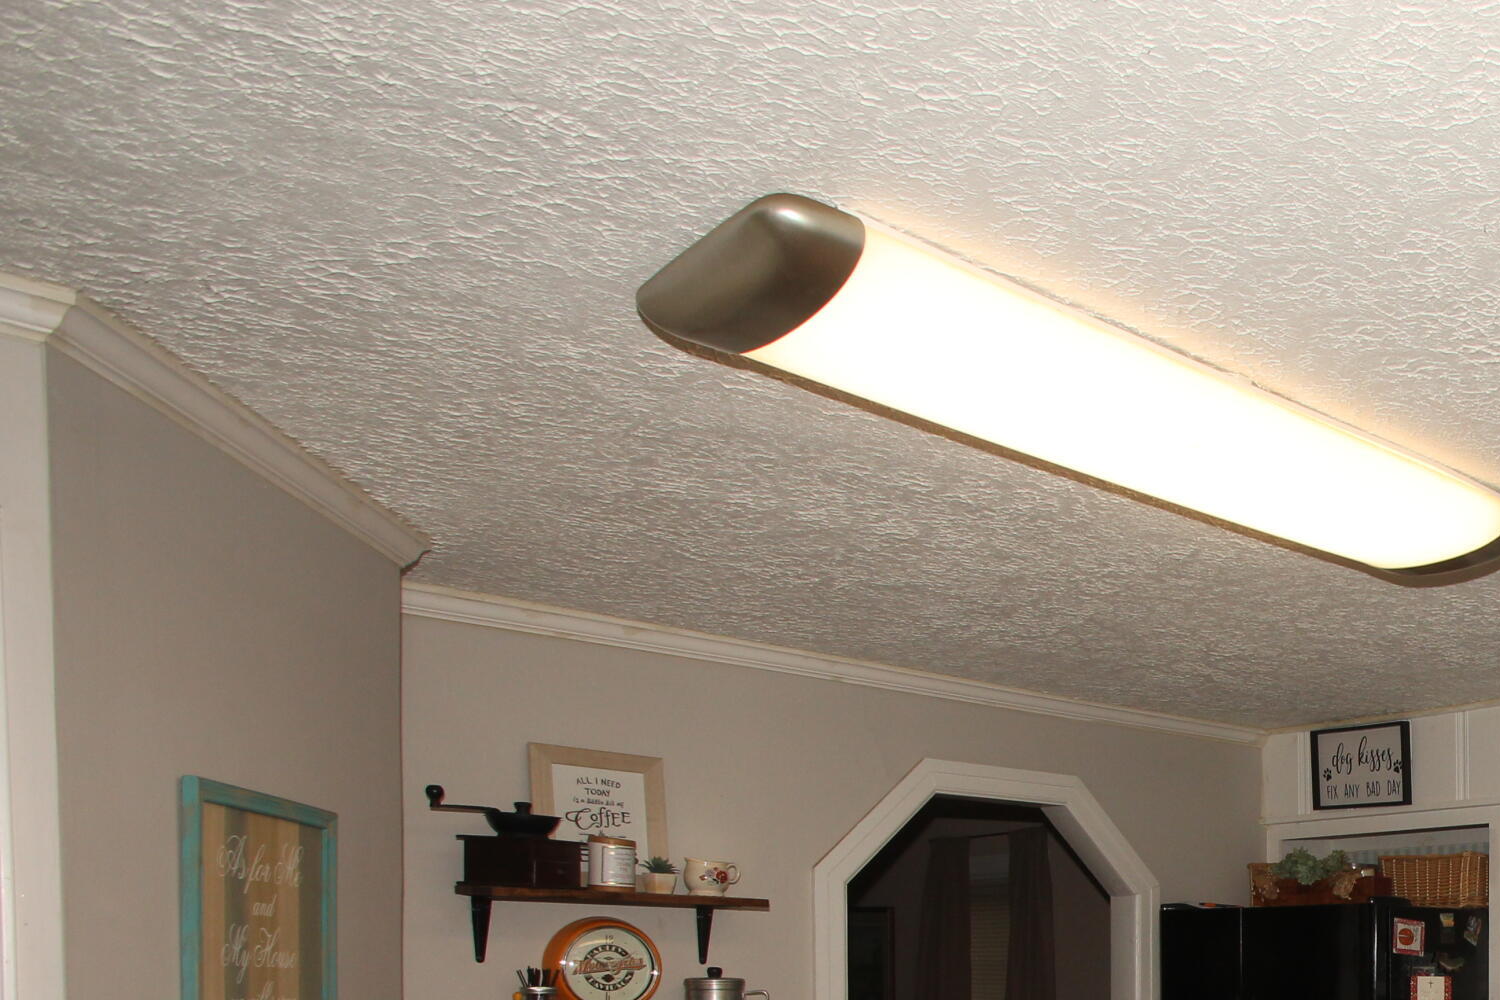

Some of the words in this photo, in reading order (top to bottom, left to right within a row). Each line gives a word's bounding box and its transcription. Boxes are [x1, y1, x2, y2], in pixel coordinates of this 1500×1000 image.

[1332, 742, 1352, 775] dog
[1358, 736, 1393, 772] kisses
[576, 777, 592, 785] ALL
[601, 778, 621, 788] NEED
[584, 787, 611, 797] TODAY
[1327, 785, 1338, 800] FIX
[1344, 784, 1360, 798] ANY
[1366, 781, 1380, 797] BAD
[1387, 780, 1400, 796] DAY
[216, 835, 247, 880] As
[244, 844, 271, 894] for
[252, 894, 277, 917] and
[222, 923, 250, 984] My
[255, 927, 297, 968] House
